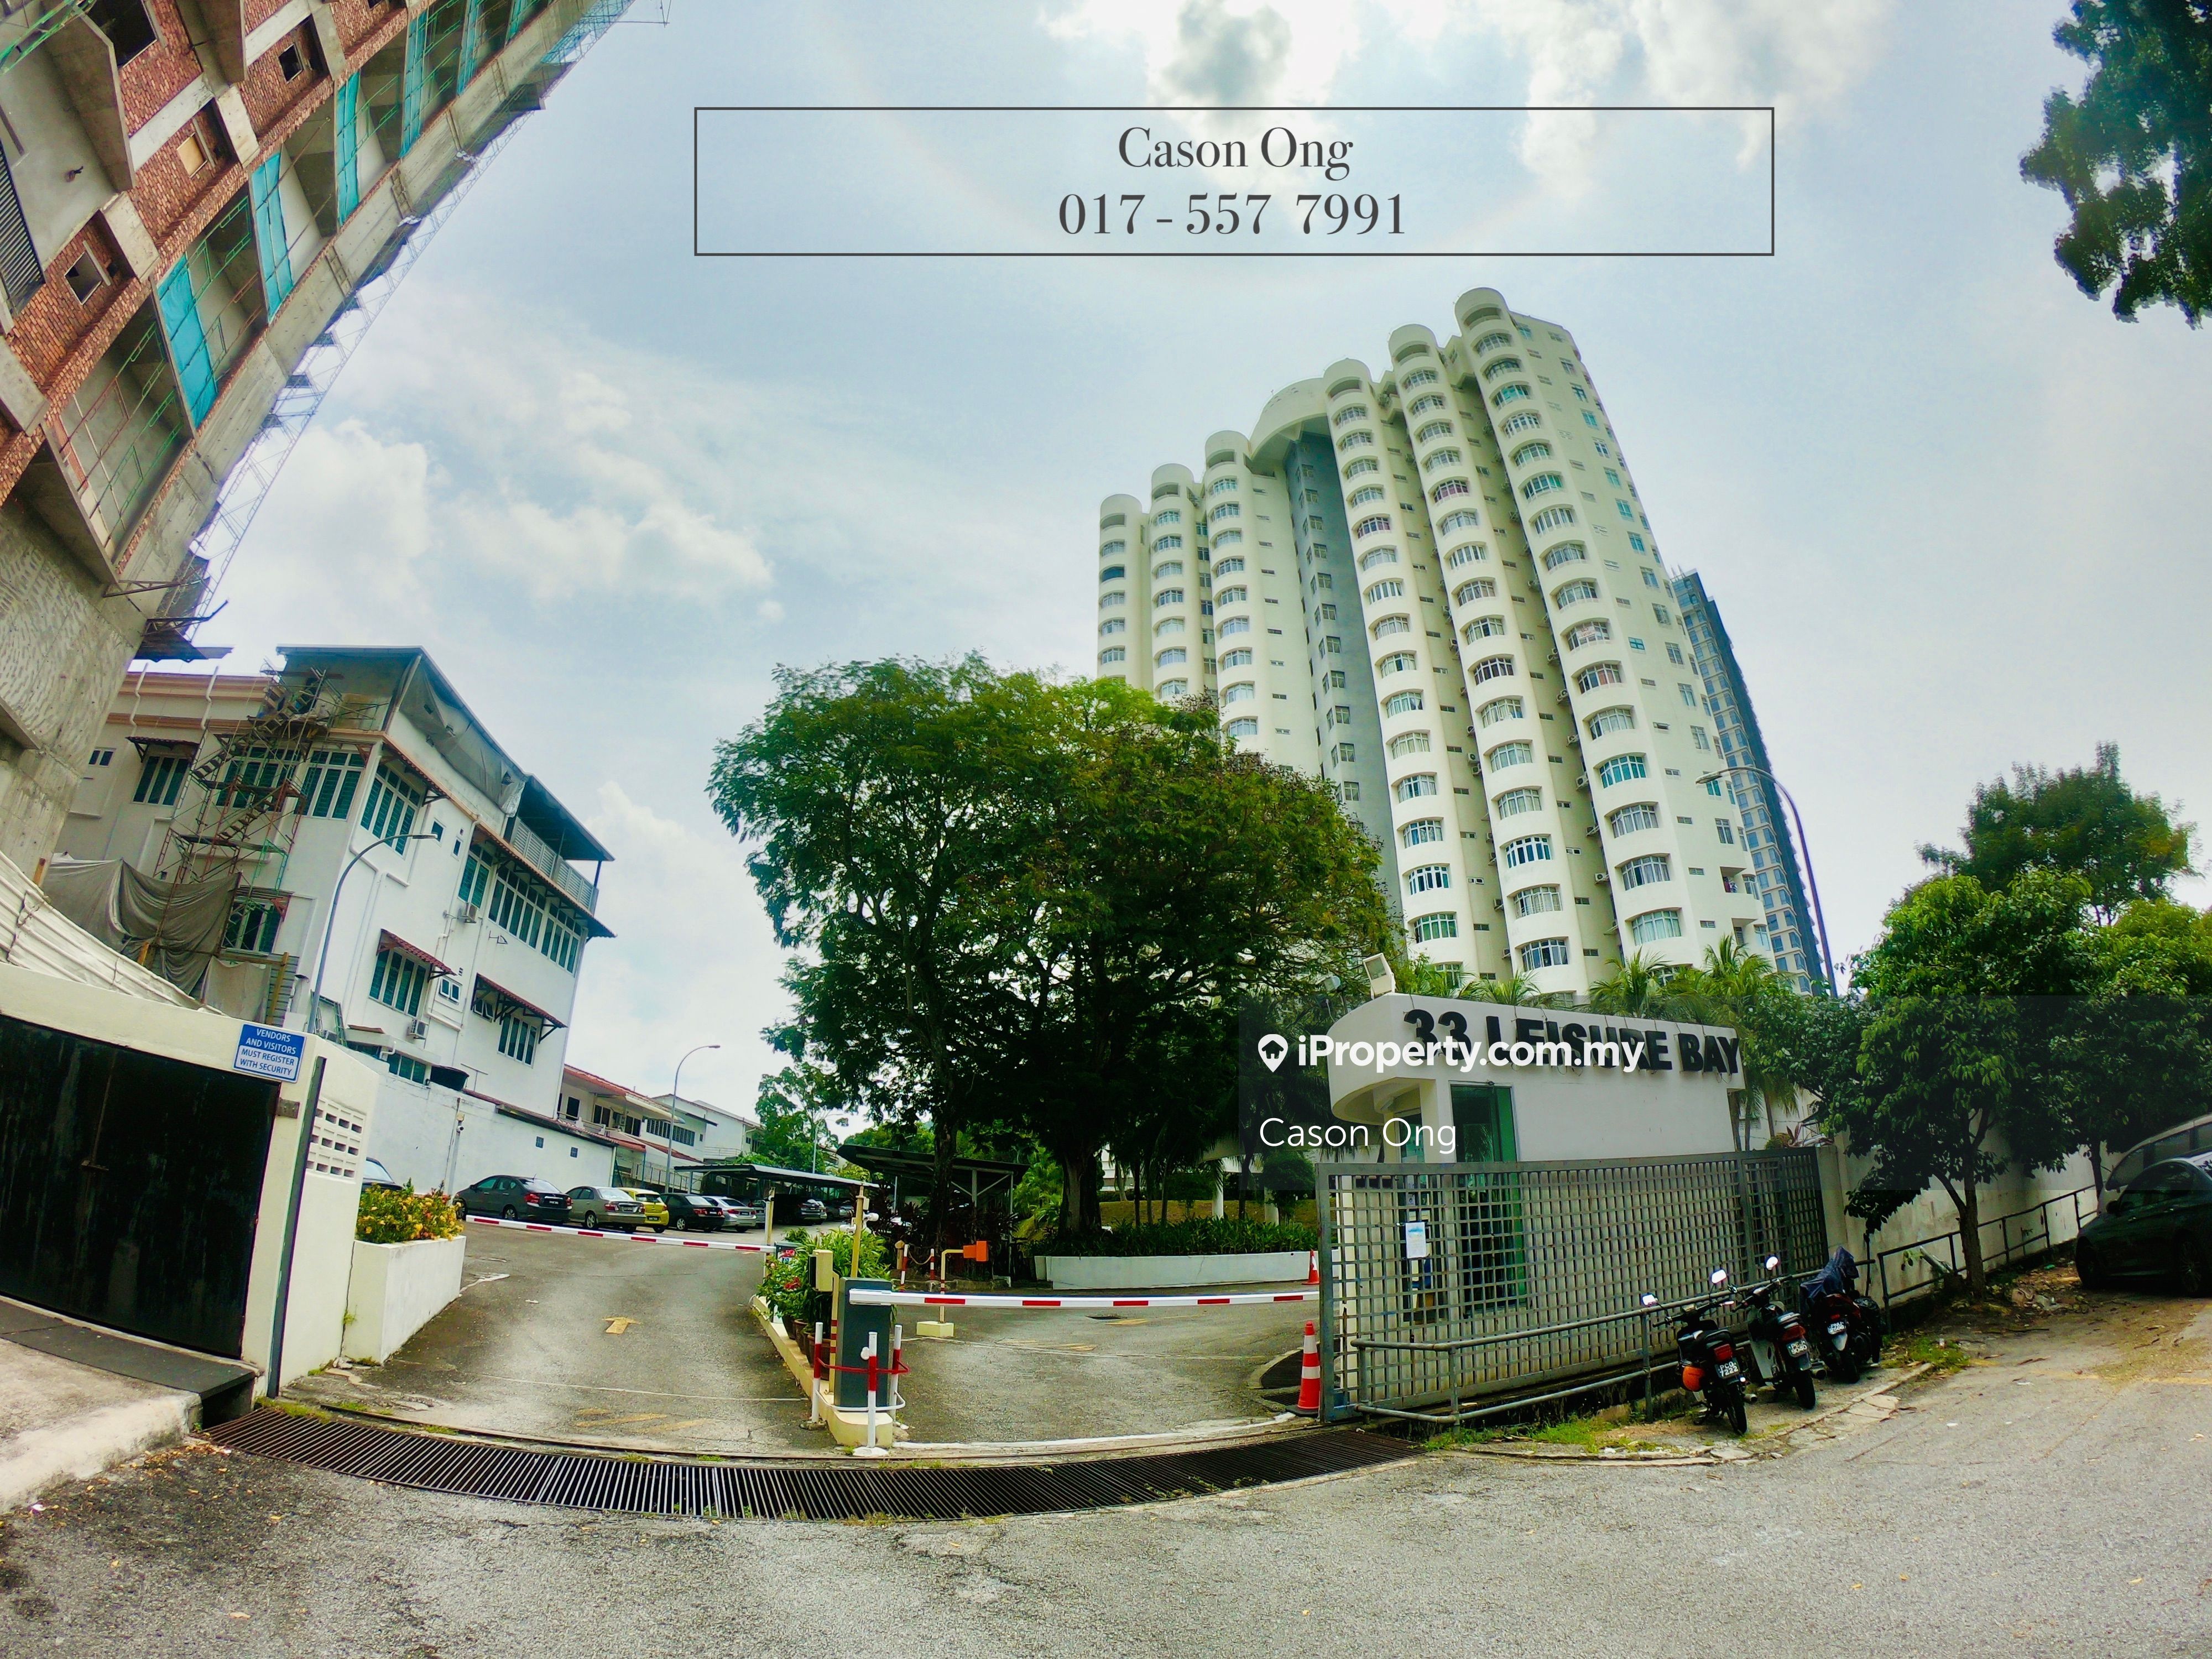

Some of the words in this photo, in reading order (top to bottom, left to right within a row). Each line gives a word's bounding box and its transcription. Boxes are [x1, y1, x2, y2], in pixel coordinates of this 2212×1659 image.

[257, 1028, 291, 1042] VENDORS
[1404, 1009, 1472, 1061] 33
[1485, 1015, 1672, 1071] LEISURE
[1677, 1033, 1740, 1074] BAY
[246, 1037, 263, 1047] AND
[264, 1041, 297, 1055] VISITORS
[241, 1048, 262, 1058] MUST
[262, 1052, 295, 1066] REGISTER
[259, 1062, 293, 1076] SECURITY
[1791, 1344, 1808, 1354] 9040
[1719, 1365, 1739, 1378] 7222
